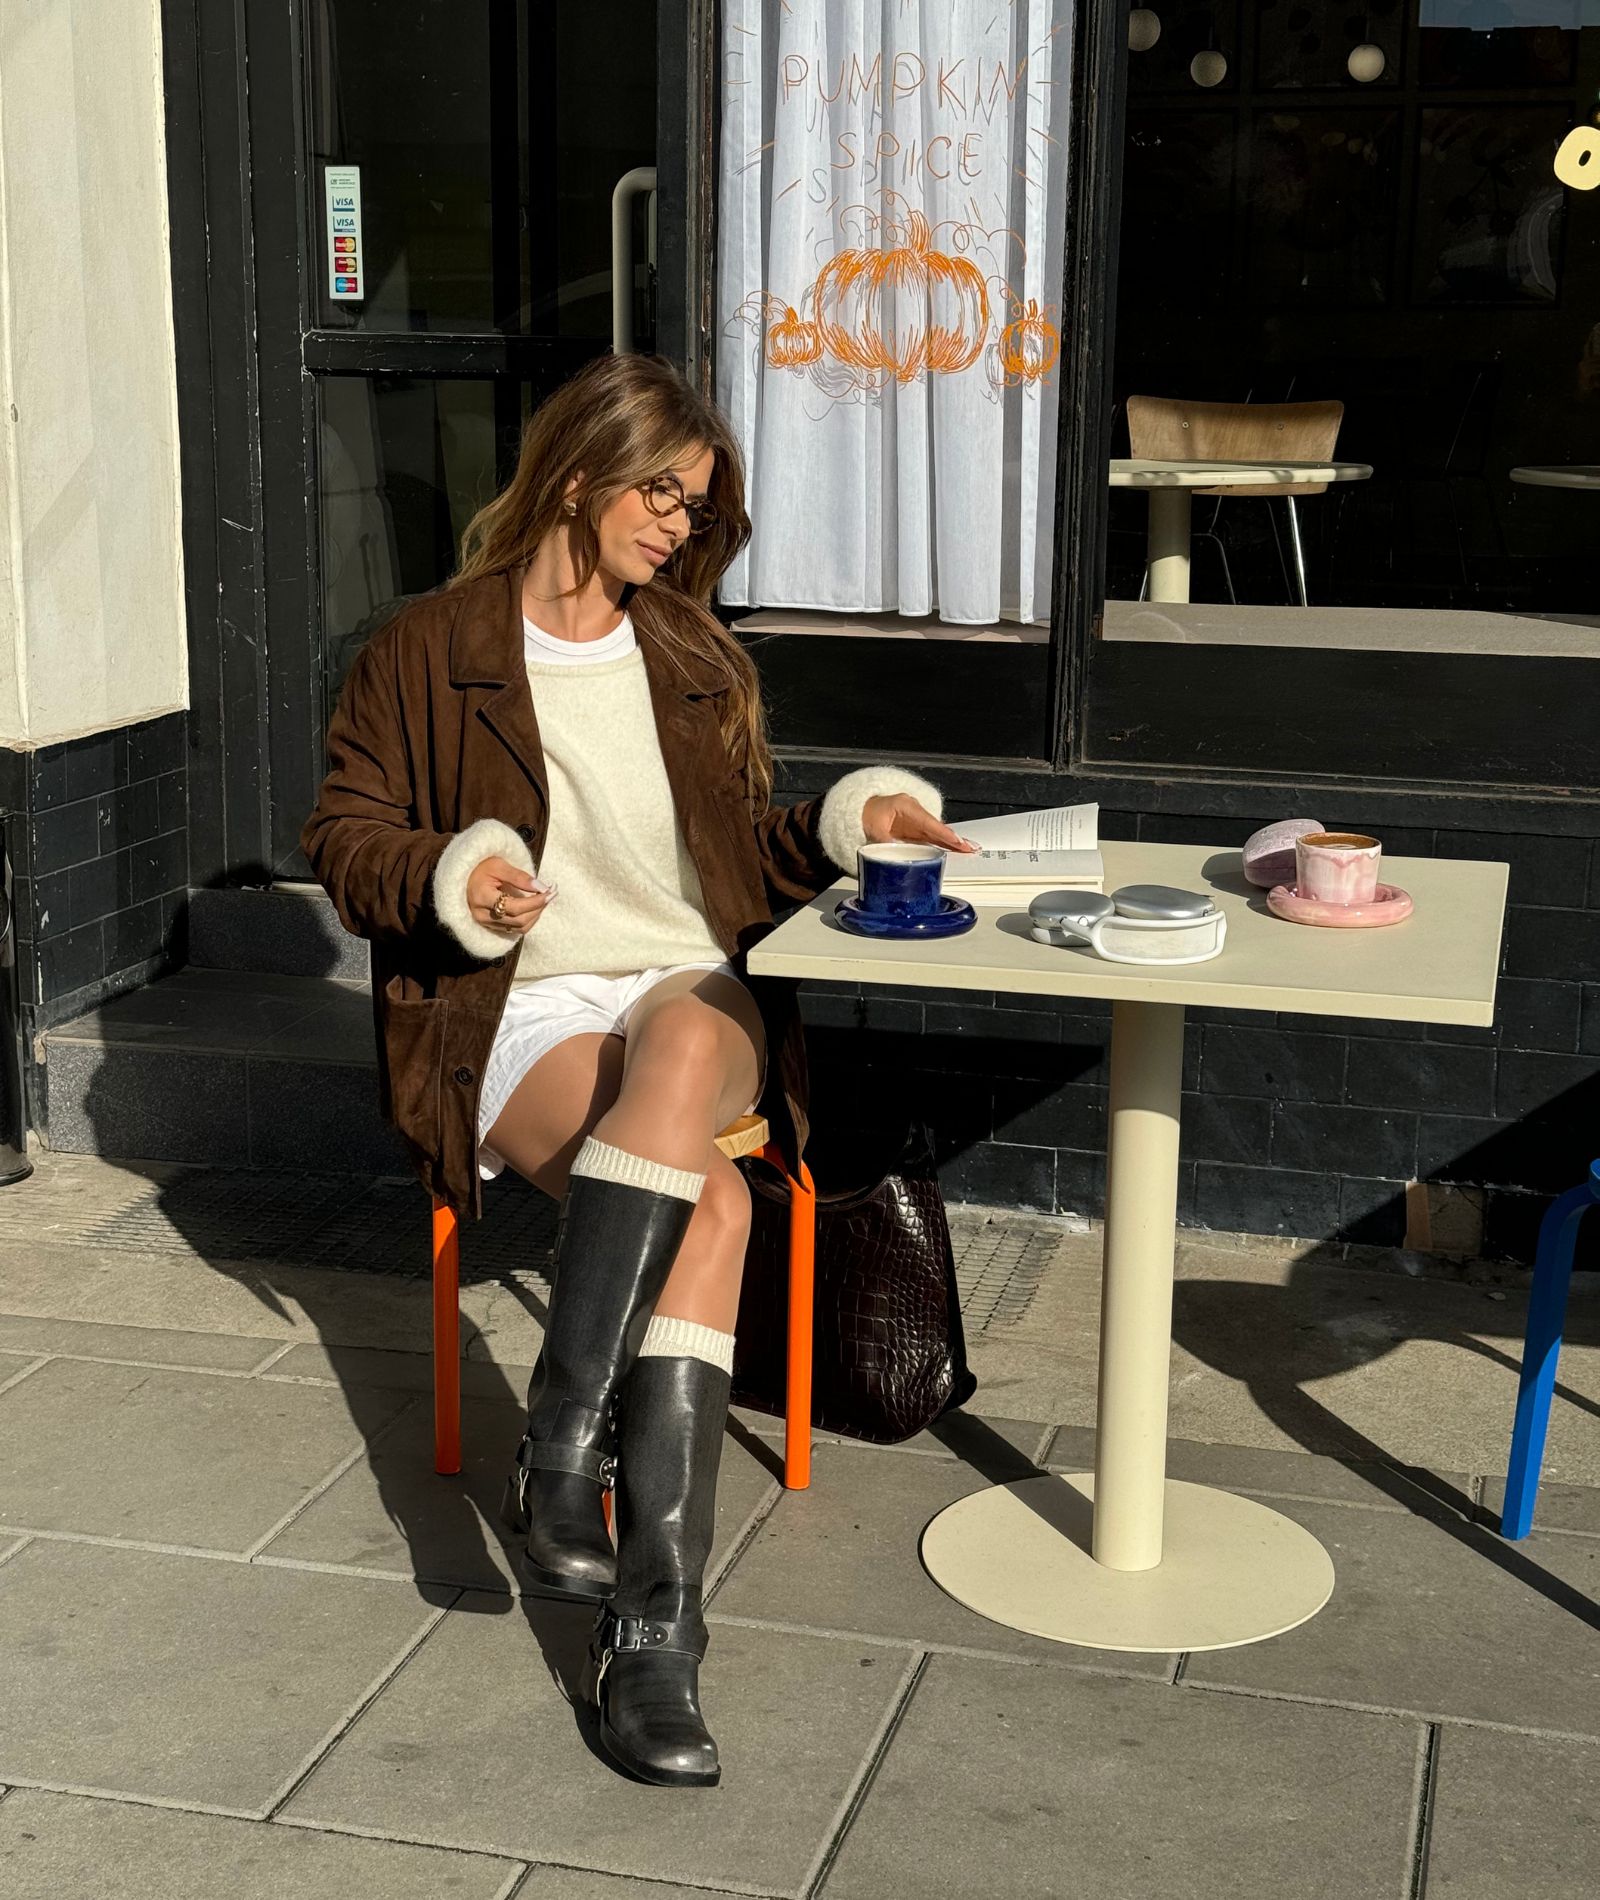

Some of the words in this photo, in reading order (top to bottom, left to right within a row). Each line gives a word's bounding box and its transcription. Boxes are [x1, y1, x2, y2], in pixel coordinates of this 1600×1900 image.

[783, 52, 1028, 111] PUMPKIN
[830, 132, 983, 181] SPICE
[335, 198, 354, 206] VISA
[336, 218, 355, 227] VISA
